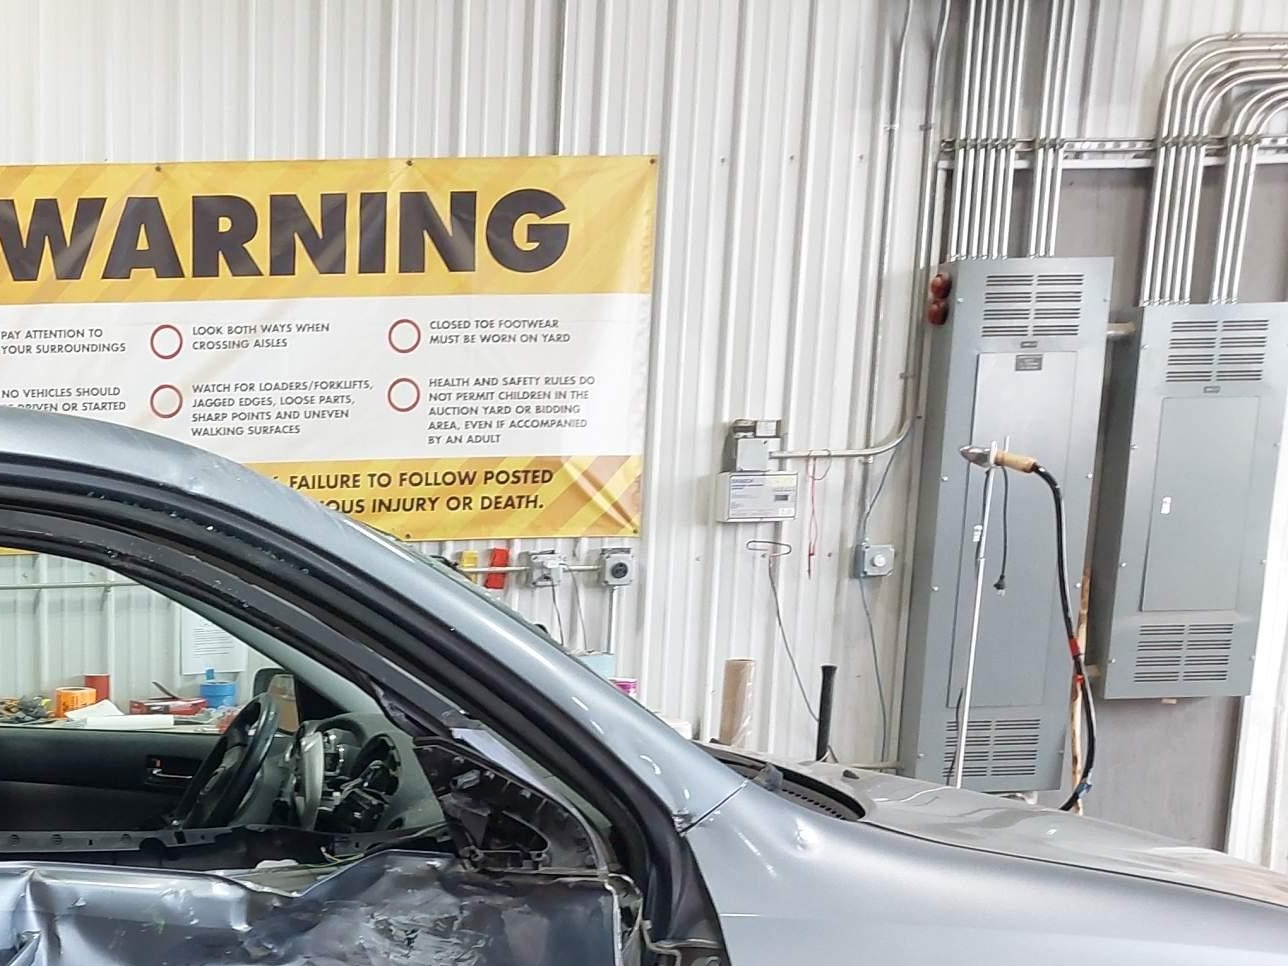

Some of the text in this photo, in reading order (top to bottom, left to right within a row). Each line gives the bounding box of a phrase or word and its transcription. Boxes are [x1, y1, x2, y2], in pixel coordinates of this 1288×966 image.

[193, 323, 330, 335] LOOK BOTH WAYS WHEN
[430, 320, 559, 329] CLOSED TOE FOOTWEAR
[1, 329, 103, 340] PAY ATTENTION TO
[429, 333, 571, 344] MUST BE WORN ON YARD
[1, 343, 126, 354] YOUR SURROUNDINGS
[193, 339, 287, 350] CROSSING AISLES
[192, 380, 373, 393] WATCH FOR LOADERS/FORKLIFTS,
[429, 376, 595, 387] HEALTH AND SAFETY RULES DO
[1, 387, 121, 398] NO VEHICLES SHOULD
[429, 390, 589, 401] NOT PERMIT CHILDREN IN THE
[62, 402, 78, 411] OR
[82, 402, 126, 411] STARTED
[193, 395, 355, 407] JAGGED EDGES, LOOSE PARTS,
[428, 405, 581, 415] AUCTION YARD OR BIDDING
[192, 410, 349, 422] SHARP POINTS AND UNEVEN
[428, 419, 587, 430] AREA, EVEN IF ACCOMPANIED
[192, 425, 300, 436] WALKING SURFACES
[428, 434, 501, 444] BY AN ADULT
[289, 470, 554, 490] FAILURE TO FOLLOW POSTED
[372, 496, 440, 513] INJURY
[446, 496, 472, 511] OR
[480, 495, 544, 510] DEATH.
